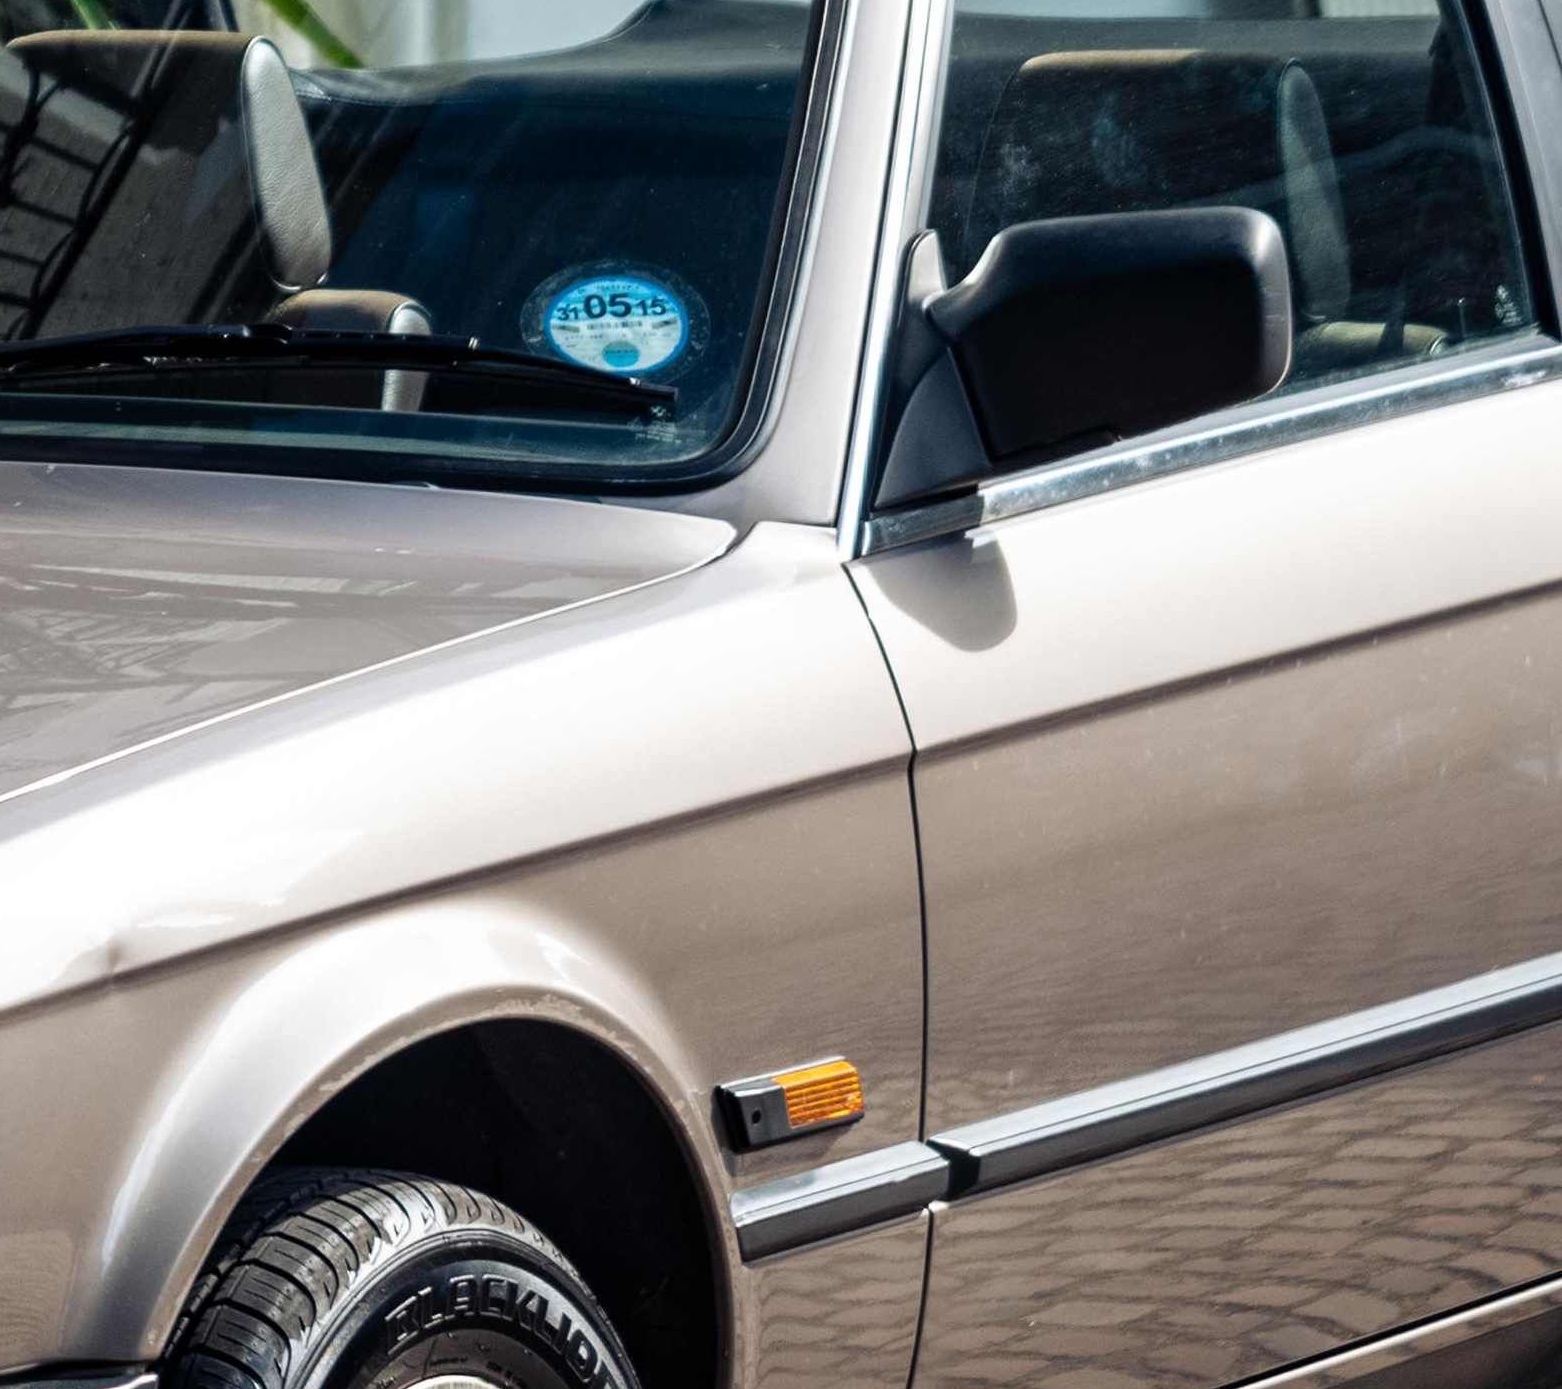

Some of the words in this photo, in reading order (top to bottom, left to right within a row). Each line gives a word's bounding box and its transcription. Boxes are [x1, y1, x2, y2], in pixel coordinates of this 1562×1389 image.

[557, 307, 580, 321] 31
[583, 293, 632, 320] 05
[636, 297, 667, 317] 15
